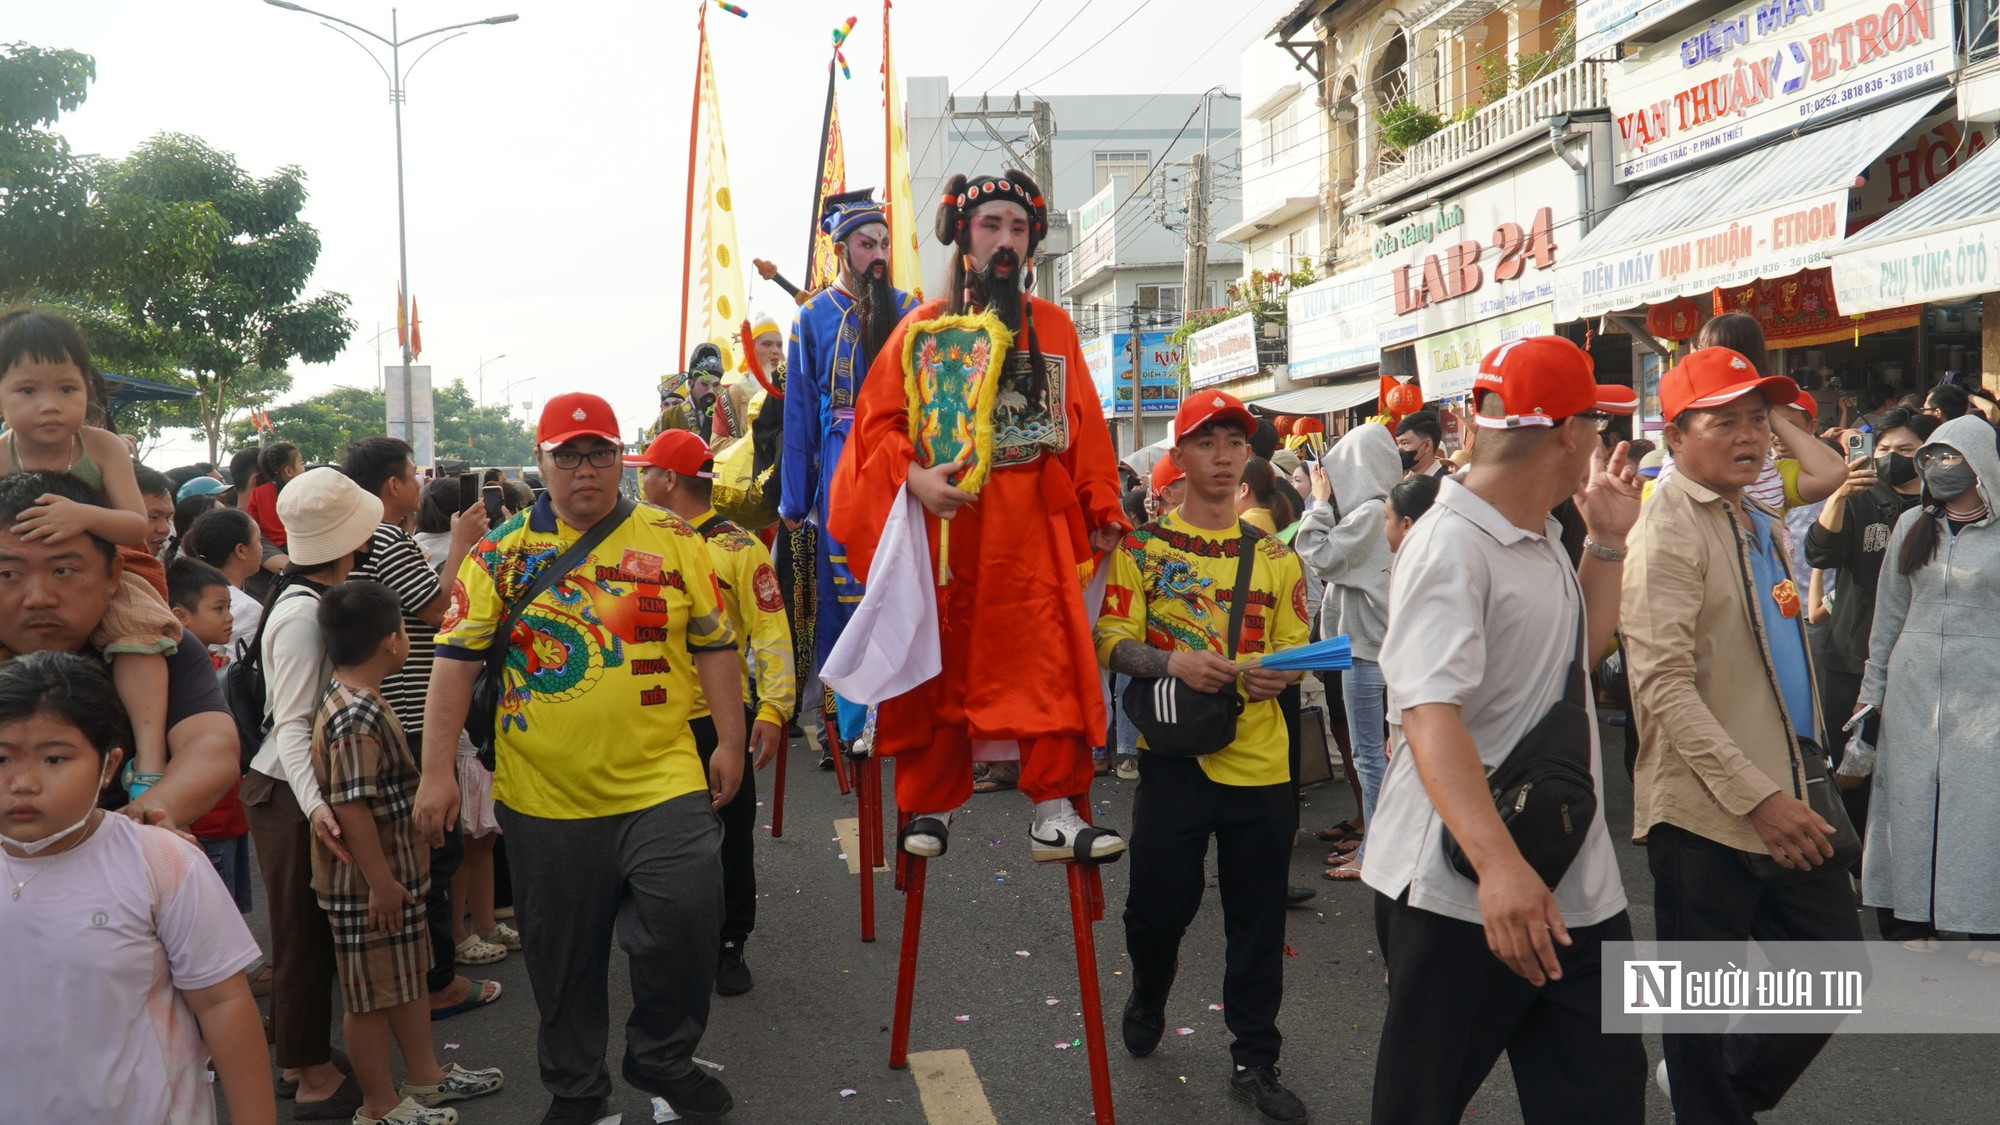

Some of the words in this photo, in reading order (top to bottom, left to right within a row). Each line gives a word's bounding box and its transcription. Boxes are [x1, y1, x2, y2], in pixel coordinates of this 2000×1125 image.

[1680, 19, 1750, 70] ĐIỆN
[1617, 99, 1670, 154] VẠN
[1673, 56, 1773, 132] THUẬN
[1808, 0, 1933, 82] ETRON
[1800, 104, 1814, 117] ĐT:
[1841, 84, 1863, 102] 3818
[1864, 77, 1883, 94] 836
[1890, 68, 1914, 86] 3818
[1916, 59, 1935, 77] 841
[1635, 162, 1644, 173] 22
[1645, 152, 1669, 170] TRƯNG
[1669, 144, 1688, 162] TRẮC
[1700, 134, 1721, 151] PHAN
[1722, 125, 1744, 143] THIẾT
[1372, 232, 1398, 259] Cửa
[1398, 220, 1434, 250] Hàng
[1434, 202, 1464, 234] Ảnh
[1582, 262, 1614, 298] ĐIỆN
[1618, 250, 1655, 287] MÁY
[1657, 241, 1692, 283] VẠN
[1696, 222, 1753, 270] THUẬN
[1771, 201, 1838, 250] ETRON
[1391, 238, 1485, 317] LAB
[1491, 206, 1559, 285] 24
[1616, 295, 1635, 308] TRẮC
[1641, 288, 1662, 302] PHAN
[1663, 282, 1686, 297] THIẾT
[1737, 261, 1781, 280] 3818.836
[1789, 253, 1827, 268] 381884
[1878, 257, 1908, 304] PHỤ
[1911, 241, 1952, 294] TÙNG
[1462, 339, 1483, 366] 24
[1499, 325, 1519, 342] Làm
[638, 596, 668, 615] KIM
[1244, 615, 1266, 630] KIM
[634, 626, 668, 642] LONG
[640, 685, 667, 706] KIẾN
